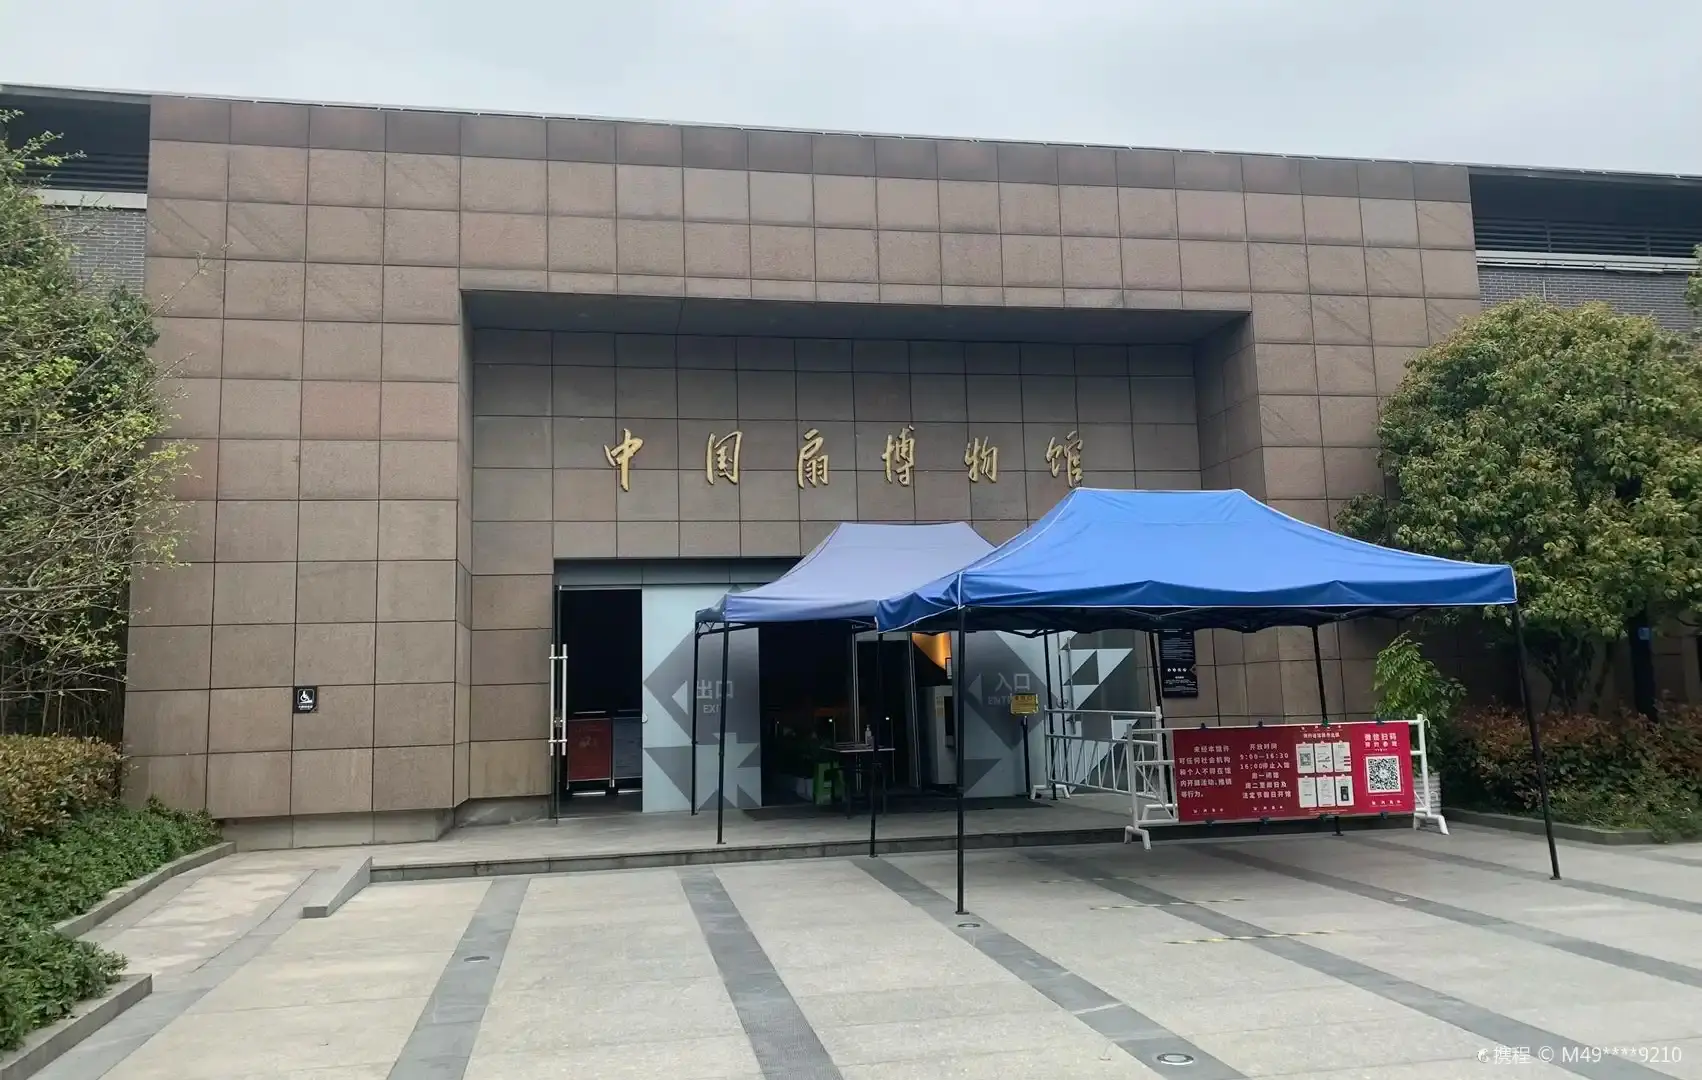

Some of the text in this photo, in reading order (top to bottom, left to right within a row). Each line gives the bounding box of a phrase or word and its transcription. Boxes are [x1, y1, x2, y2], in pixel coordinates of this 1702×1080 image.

[604, 426, 1084, 491] 中国扇博物馆
[697, 680, 733, 699] 出口
[995, 672, 1030, 693] 入口
